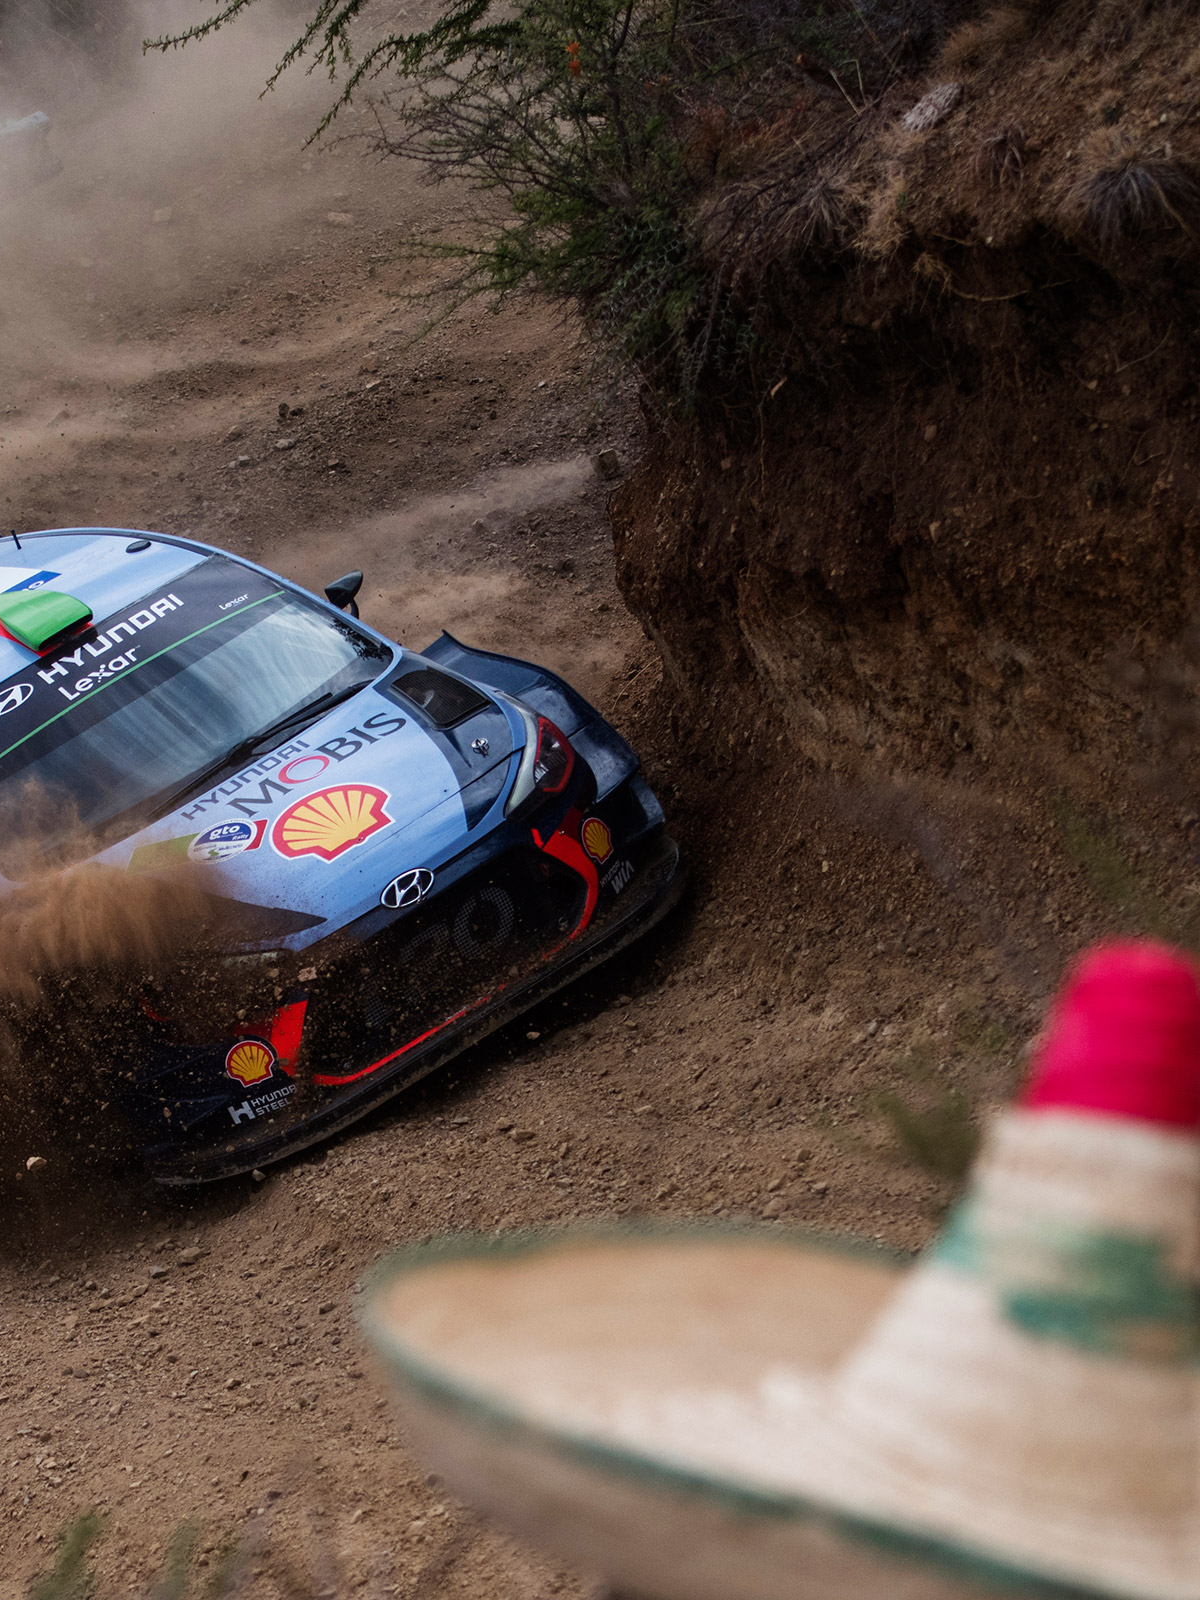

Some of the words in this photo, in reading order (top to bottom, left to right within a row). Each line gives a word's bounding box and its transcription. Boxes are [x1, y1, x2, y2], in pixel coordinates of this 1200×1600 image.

[36, 593, 184, 684] HYUNDAI
[58, 646, 139, 700] Lexar
[180, 739, 311, 820] HYUNDAI
[226, 712, 407, 818] MOBIS
[209, 825, 240, 840] gto
[250, 1084, 297, 1108] HYUNDA
[255, 1098, 292, 1116] STEEL
